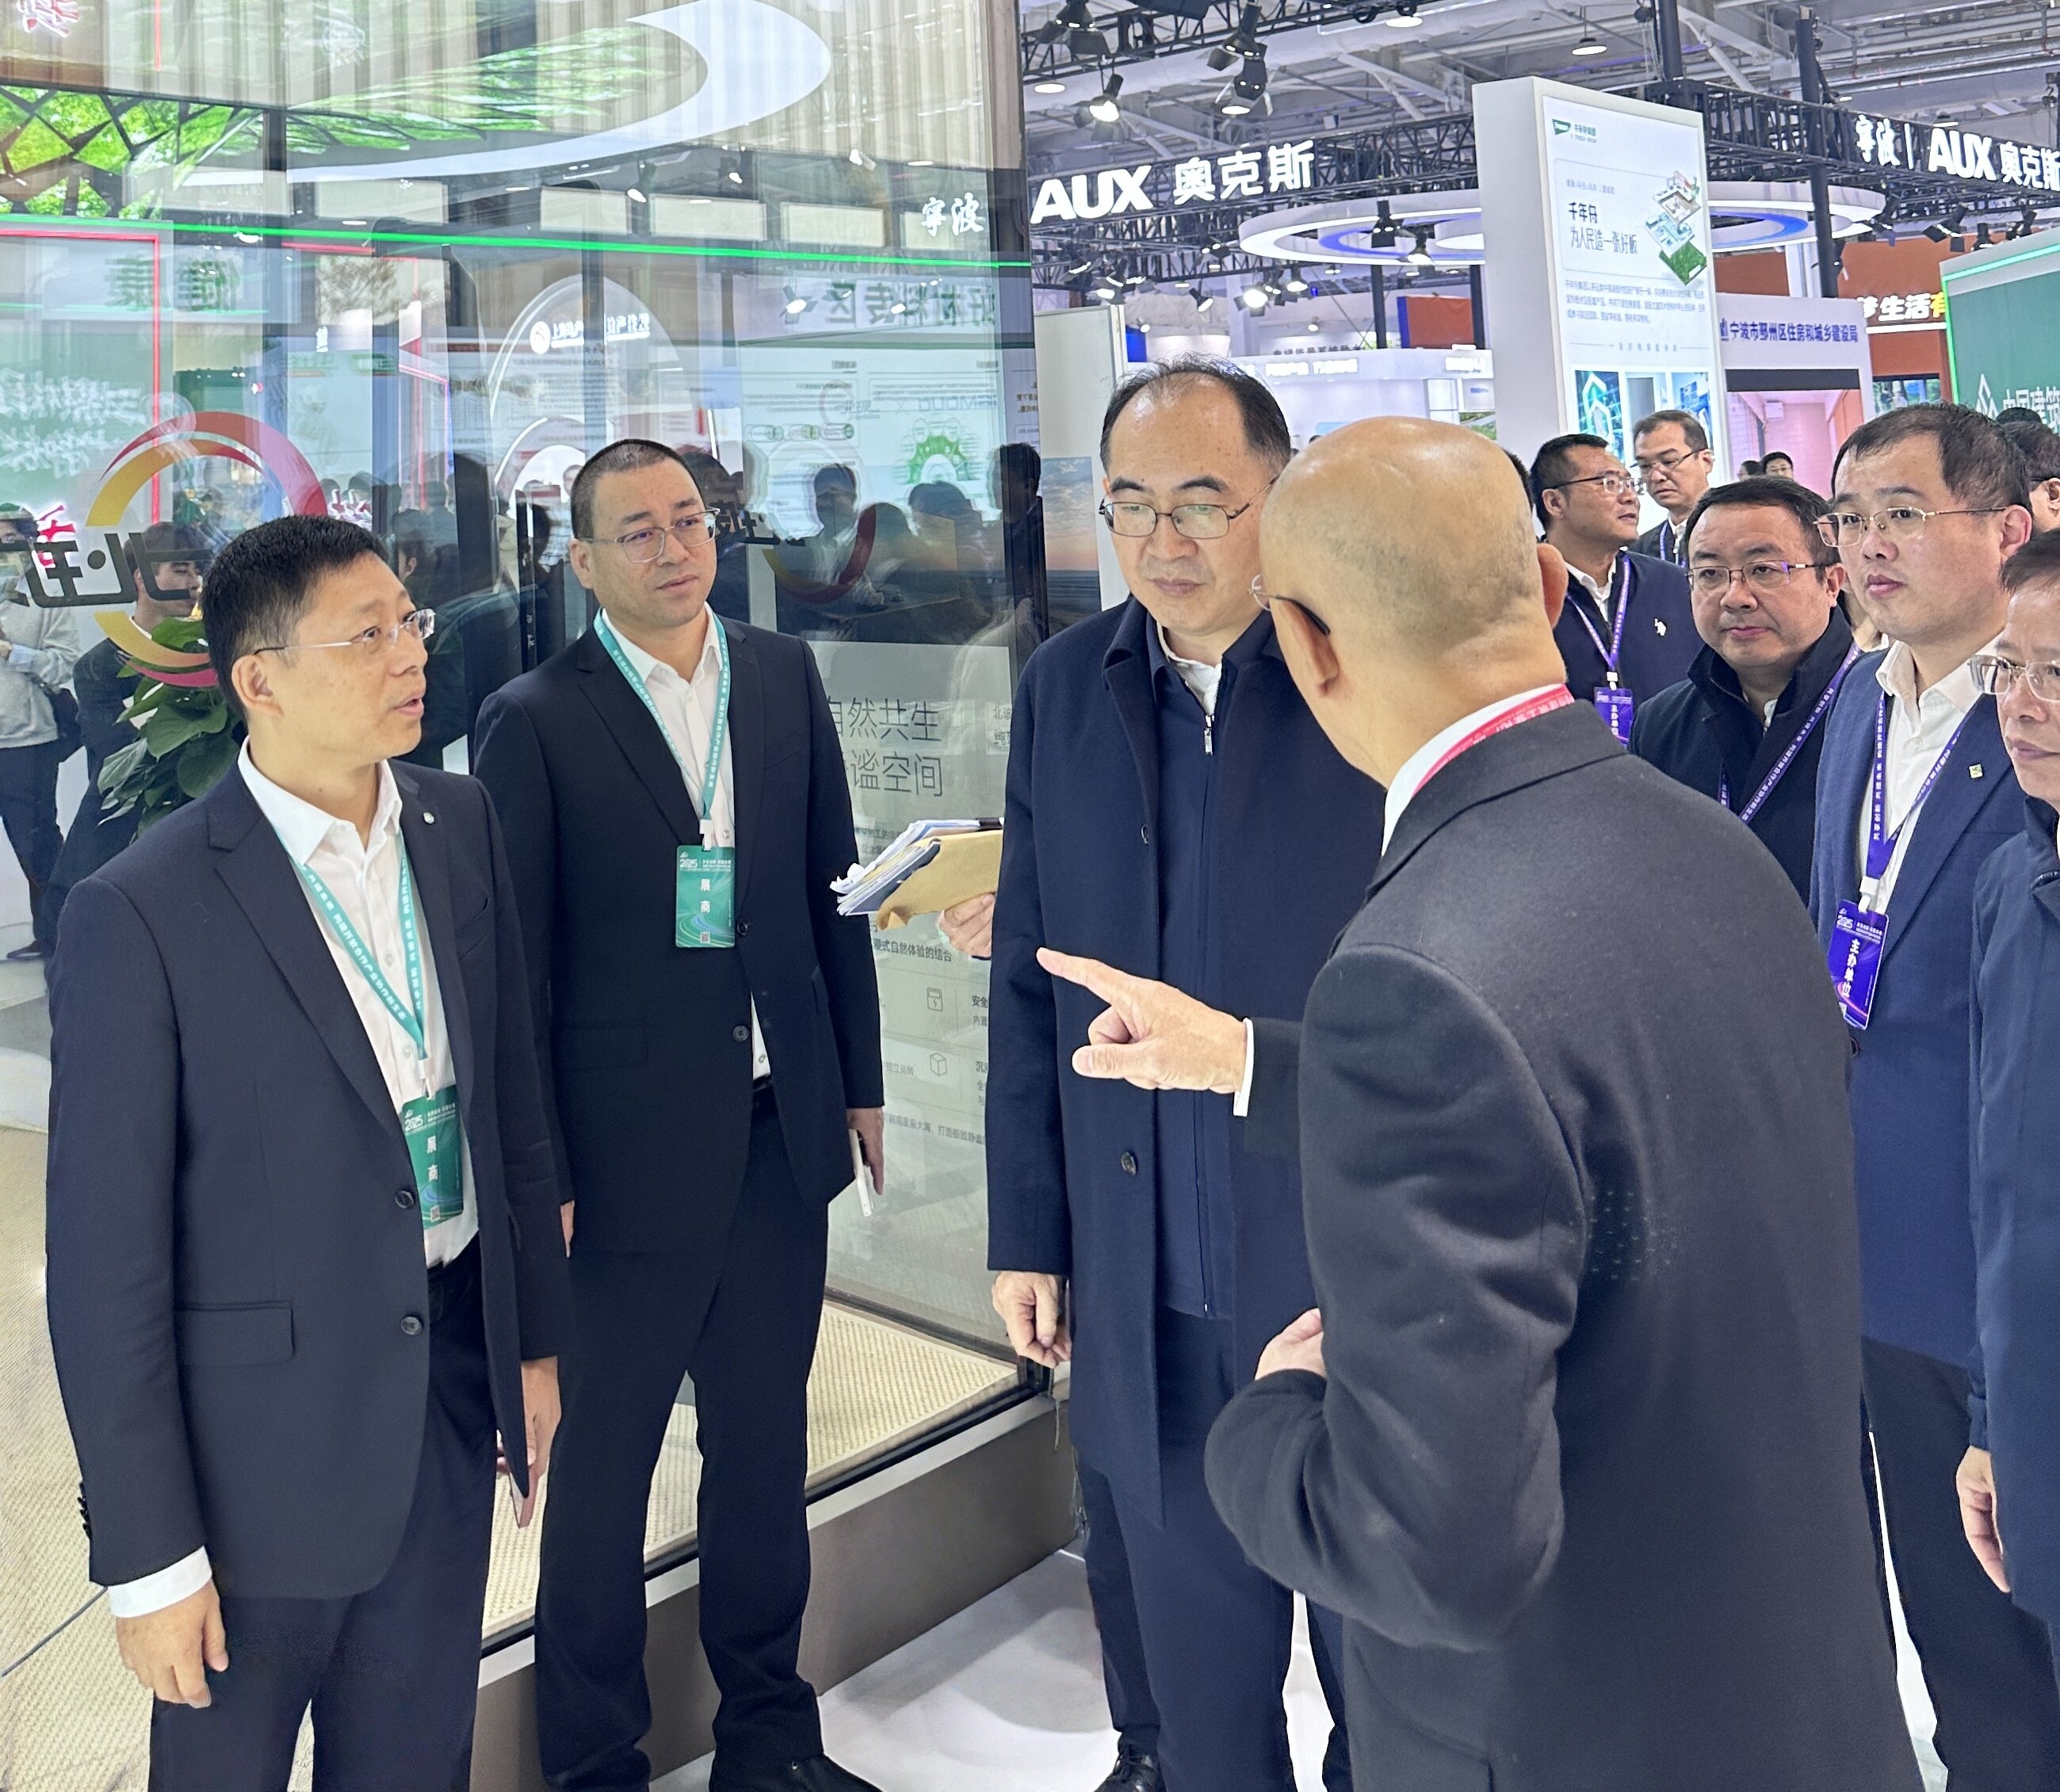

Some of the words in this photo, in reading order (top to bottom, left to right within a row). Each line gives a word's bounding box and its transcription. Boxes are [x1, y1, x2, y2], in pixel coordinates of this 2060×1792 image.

[1030, 165, 1153, 224] AUX
[1173, 139, 1315, 205] 奥克斯
[1928, 128, 1997, 181] AUX
[2000, 141, 2060, 192] 奥克斯
[1569, 201, 1598, 224] 千年舟
[827, 695, 942, 742] 自然共生
[843, 748, 943, 797] 谧空间
